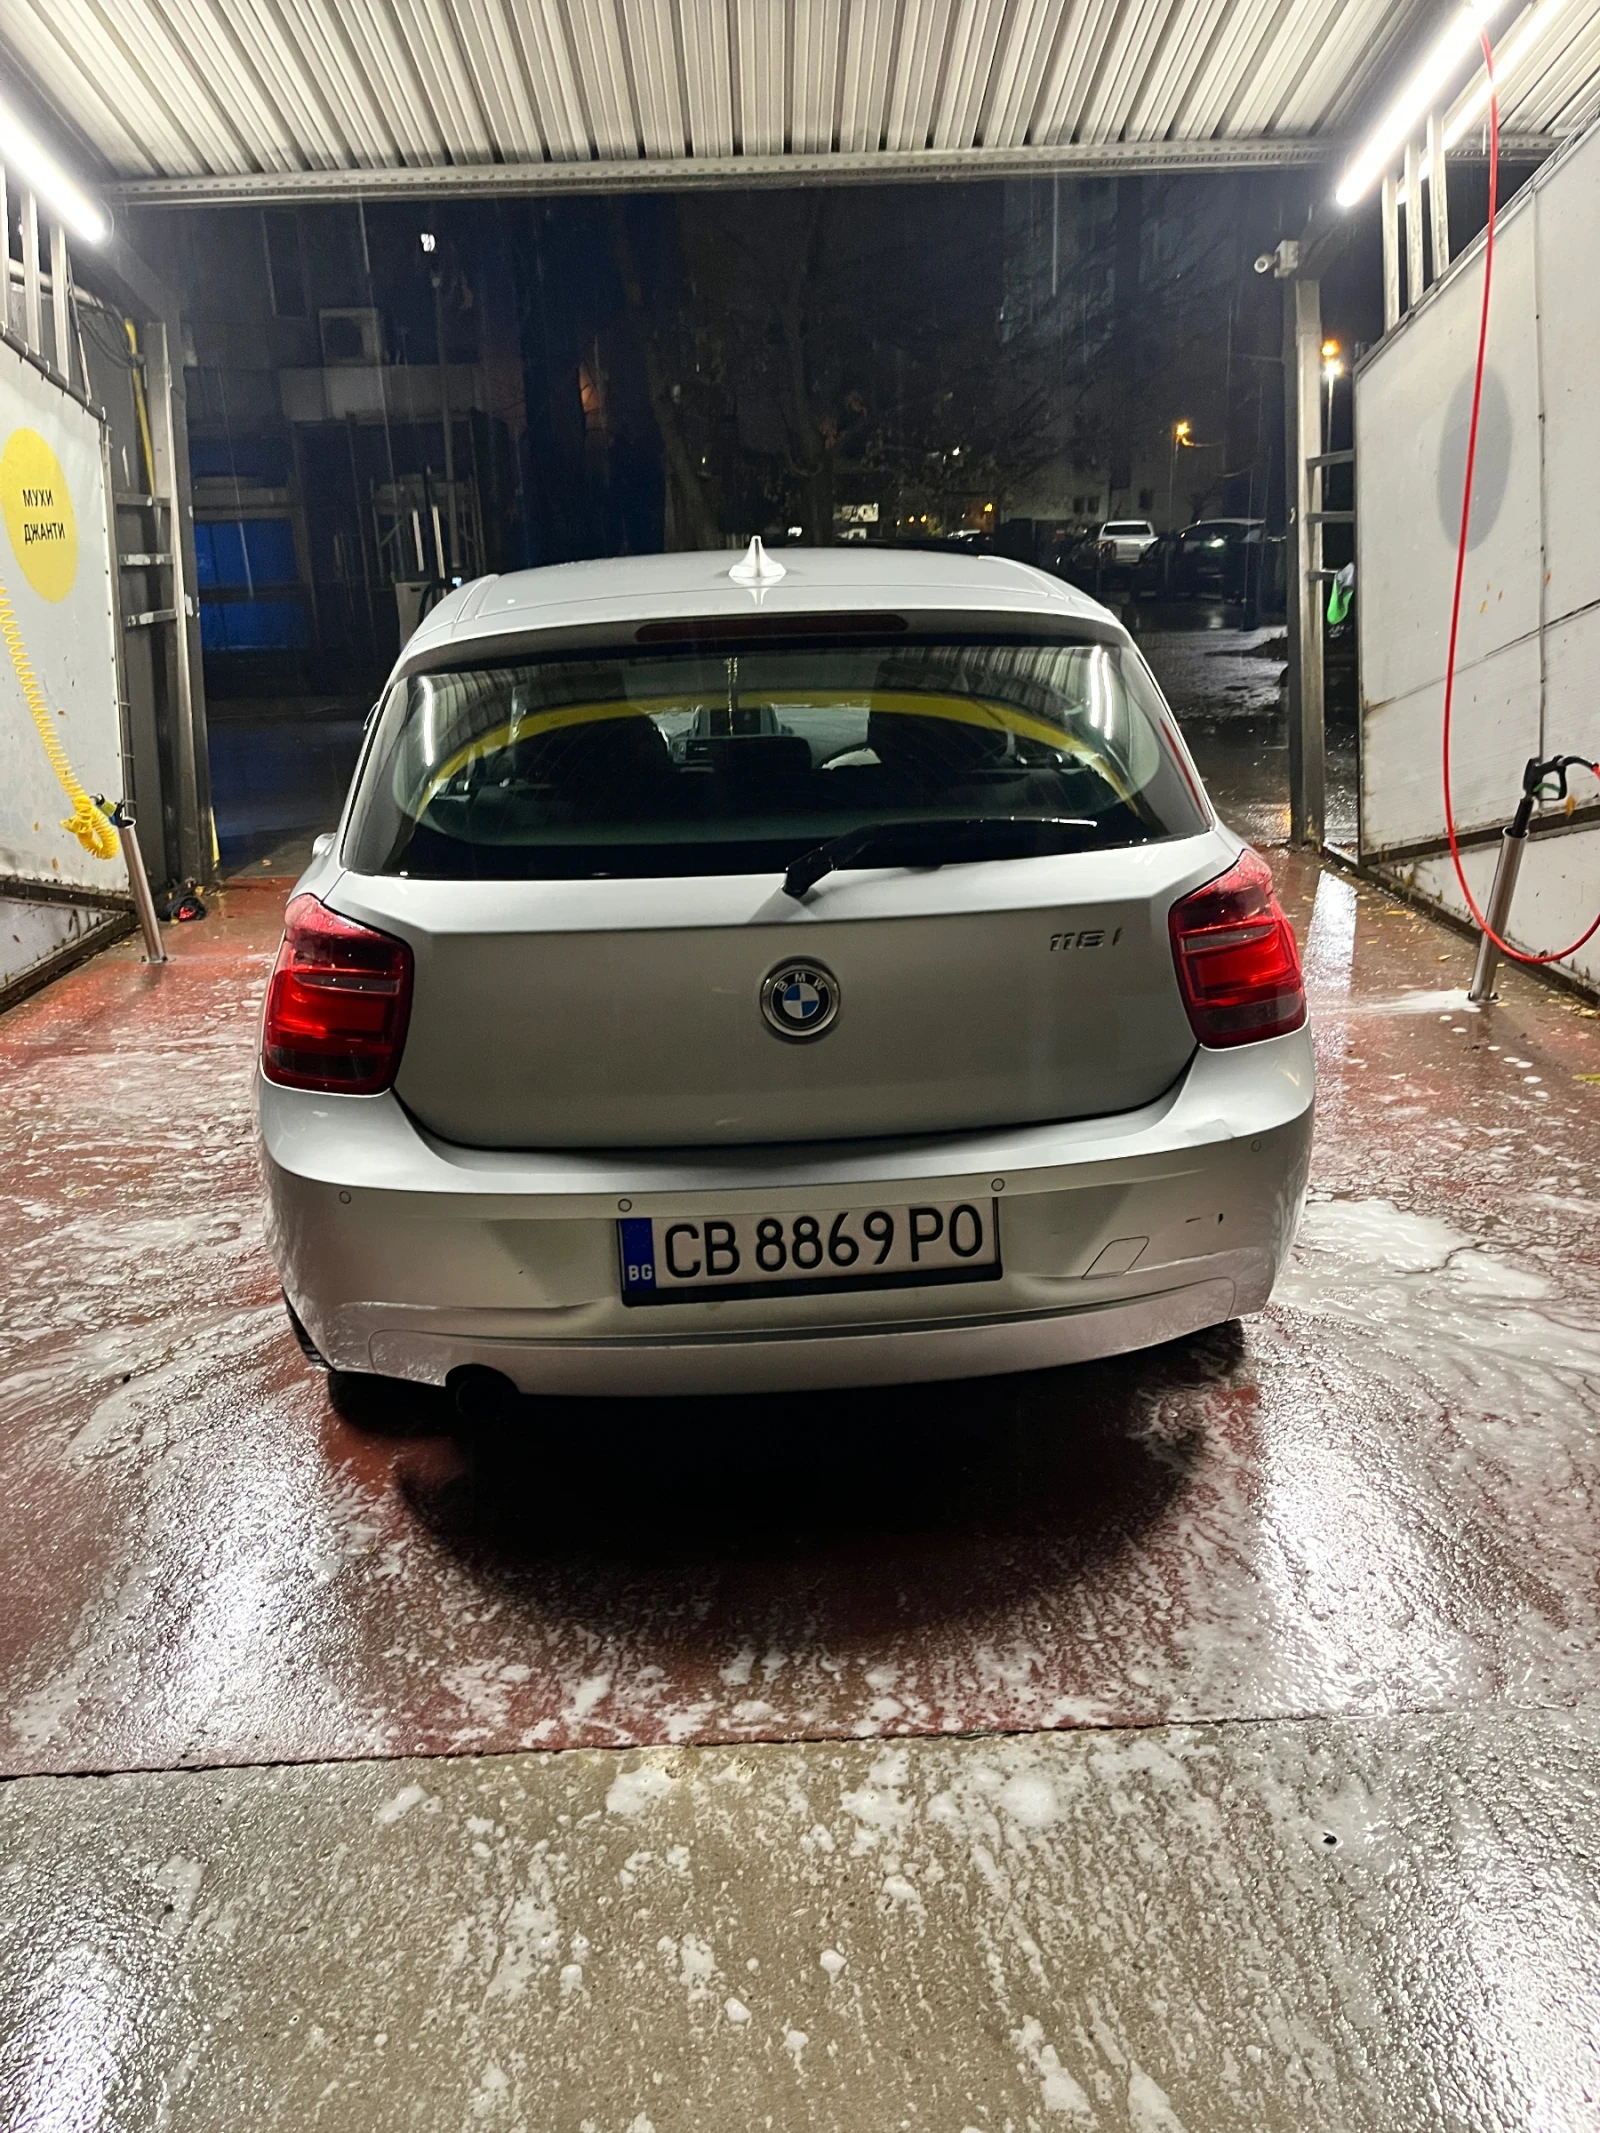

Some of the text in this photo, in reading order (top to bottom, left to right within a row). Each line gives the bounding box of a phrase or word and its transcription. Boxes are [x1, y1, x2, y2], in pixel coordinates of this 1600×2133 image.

[22, 489, 54, 507] МУХИ
[24, 522, 66, 545] ДЖАНТИ
[777, 973, 827, 992] BMW
[665, 1221, 740, 1278] CB
[755, 1211, 894, 1272] 8869
[628, 1264, 653, 1281] BG
